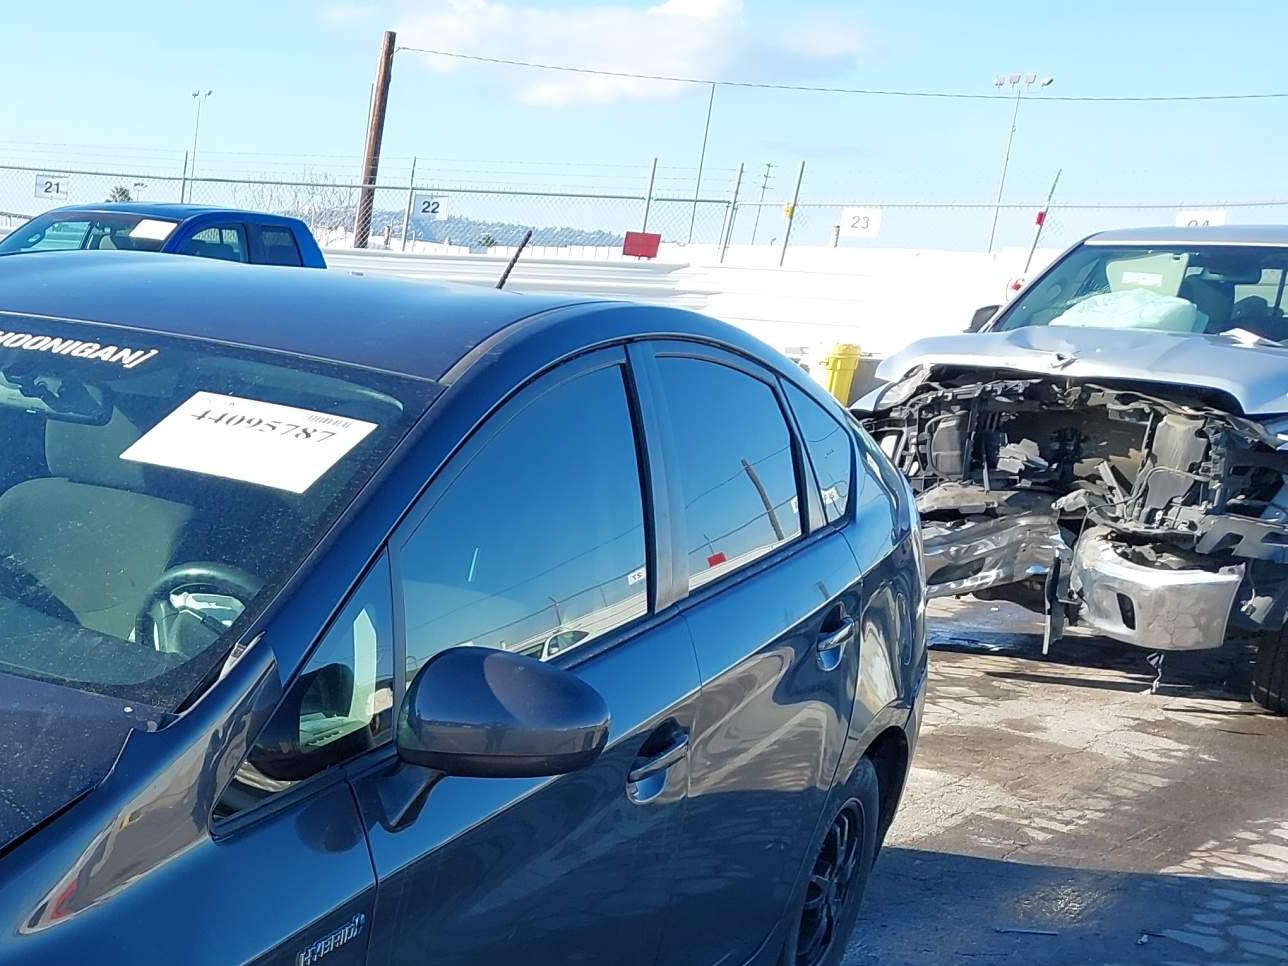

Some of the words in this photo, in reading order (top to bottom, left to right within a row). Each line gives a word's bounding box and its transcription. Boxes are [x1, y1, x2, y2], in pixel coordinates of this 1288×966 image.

[43, 180, 60, 194] 21
[421, 200, 440, 214] 22
[850, 215, 870, 229] 23
[191, 409, 338, 443] 44095787
